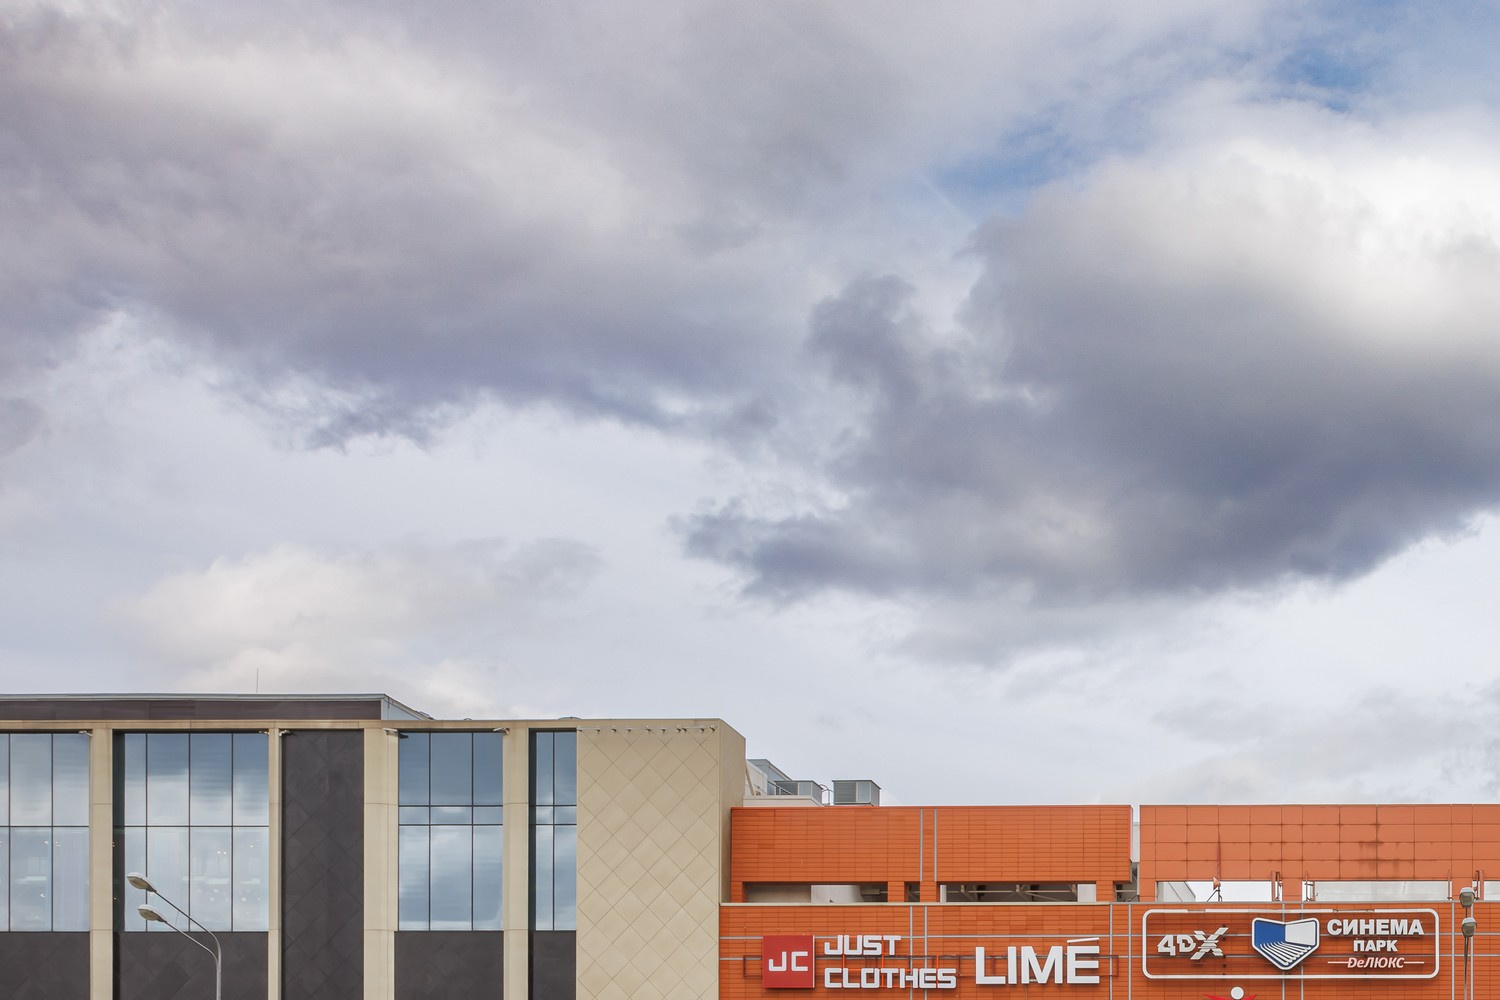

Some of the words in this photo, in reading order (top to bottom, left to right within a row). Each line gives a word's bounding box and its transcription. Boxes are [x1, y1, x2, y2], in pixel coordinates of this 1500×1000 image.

[1327, 918, 1425, 936] СИНЕМА
[824, 934, 901, 956] JUST
[1156, 927, 1229, 961] 4DX
[1353, 939, 1398, 952] ПАРК
[768, 951, 809, 972] JC
[824, 968, 957, 989] CLOTHES
